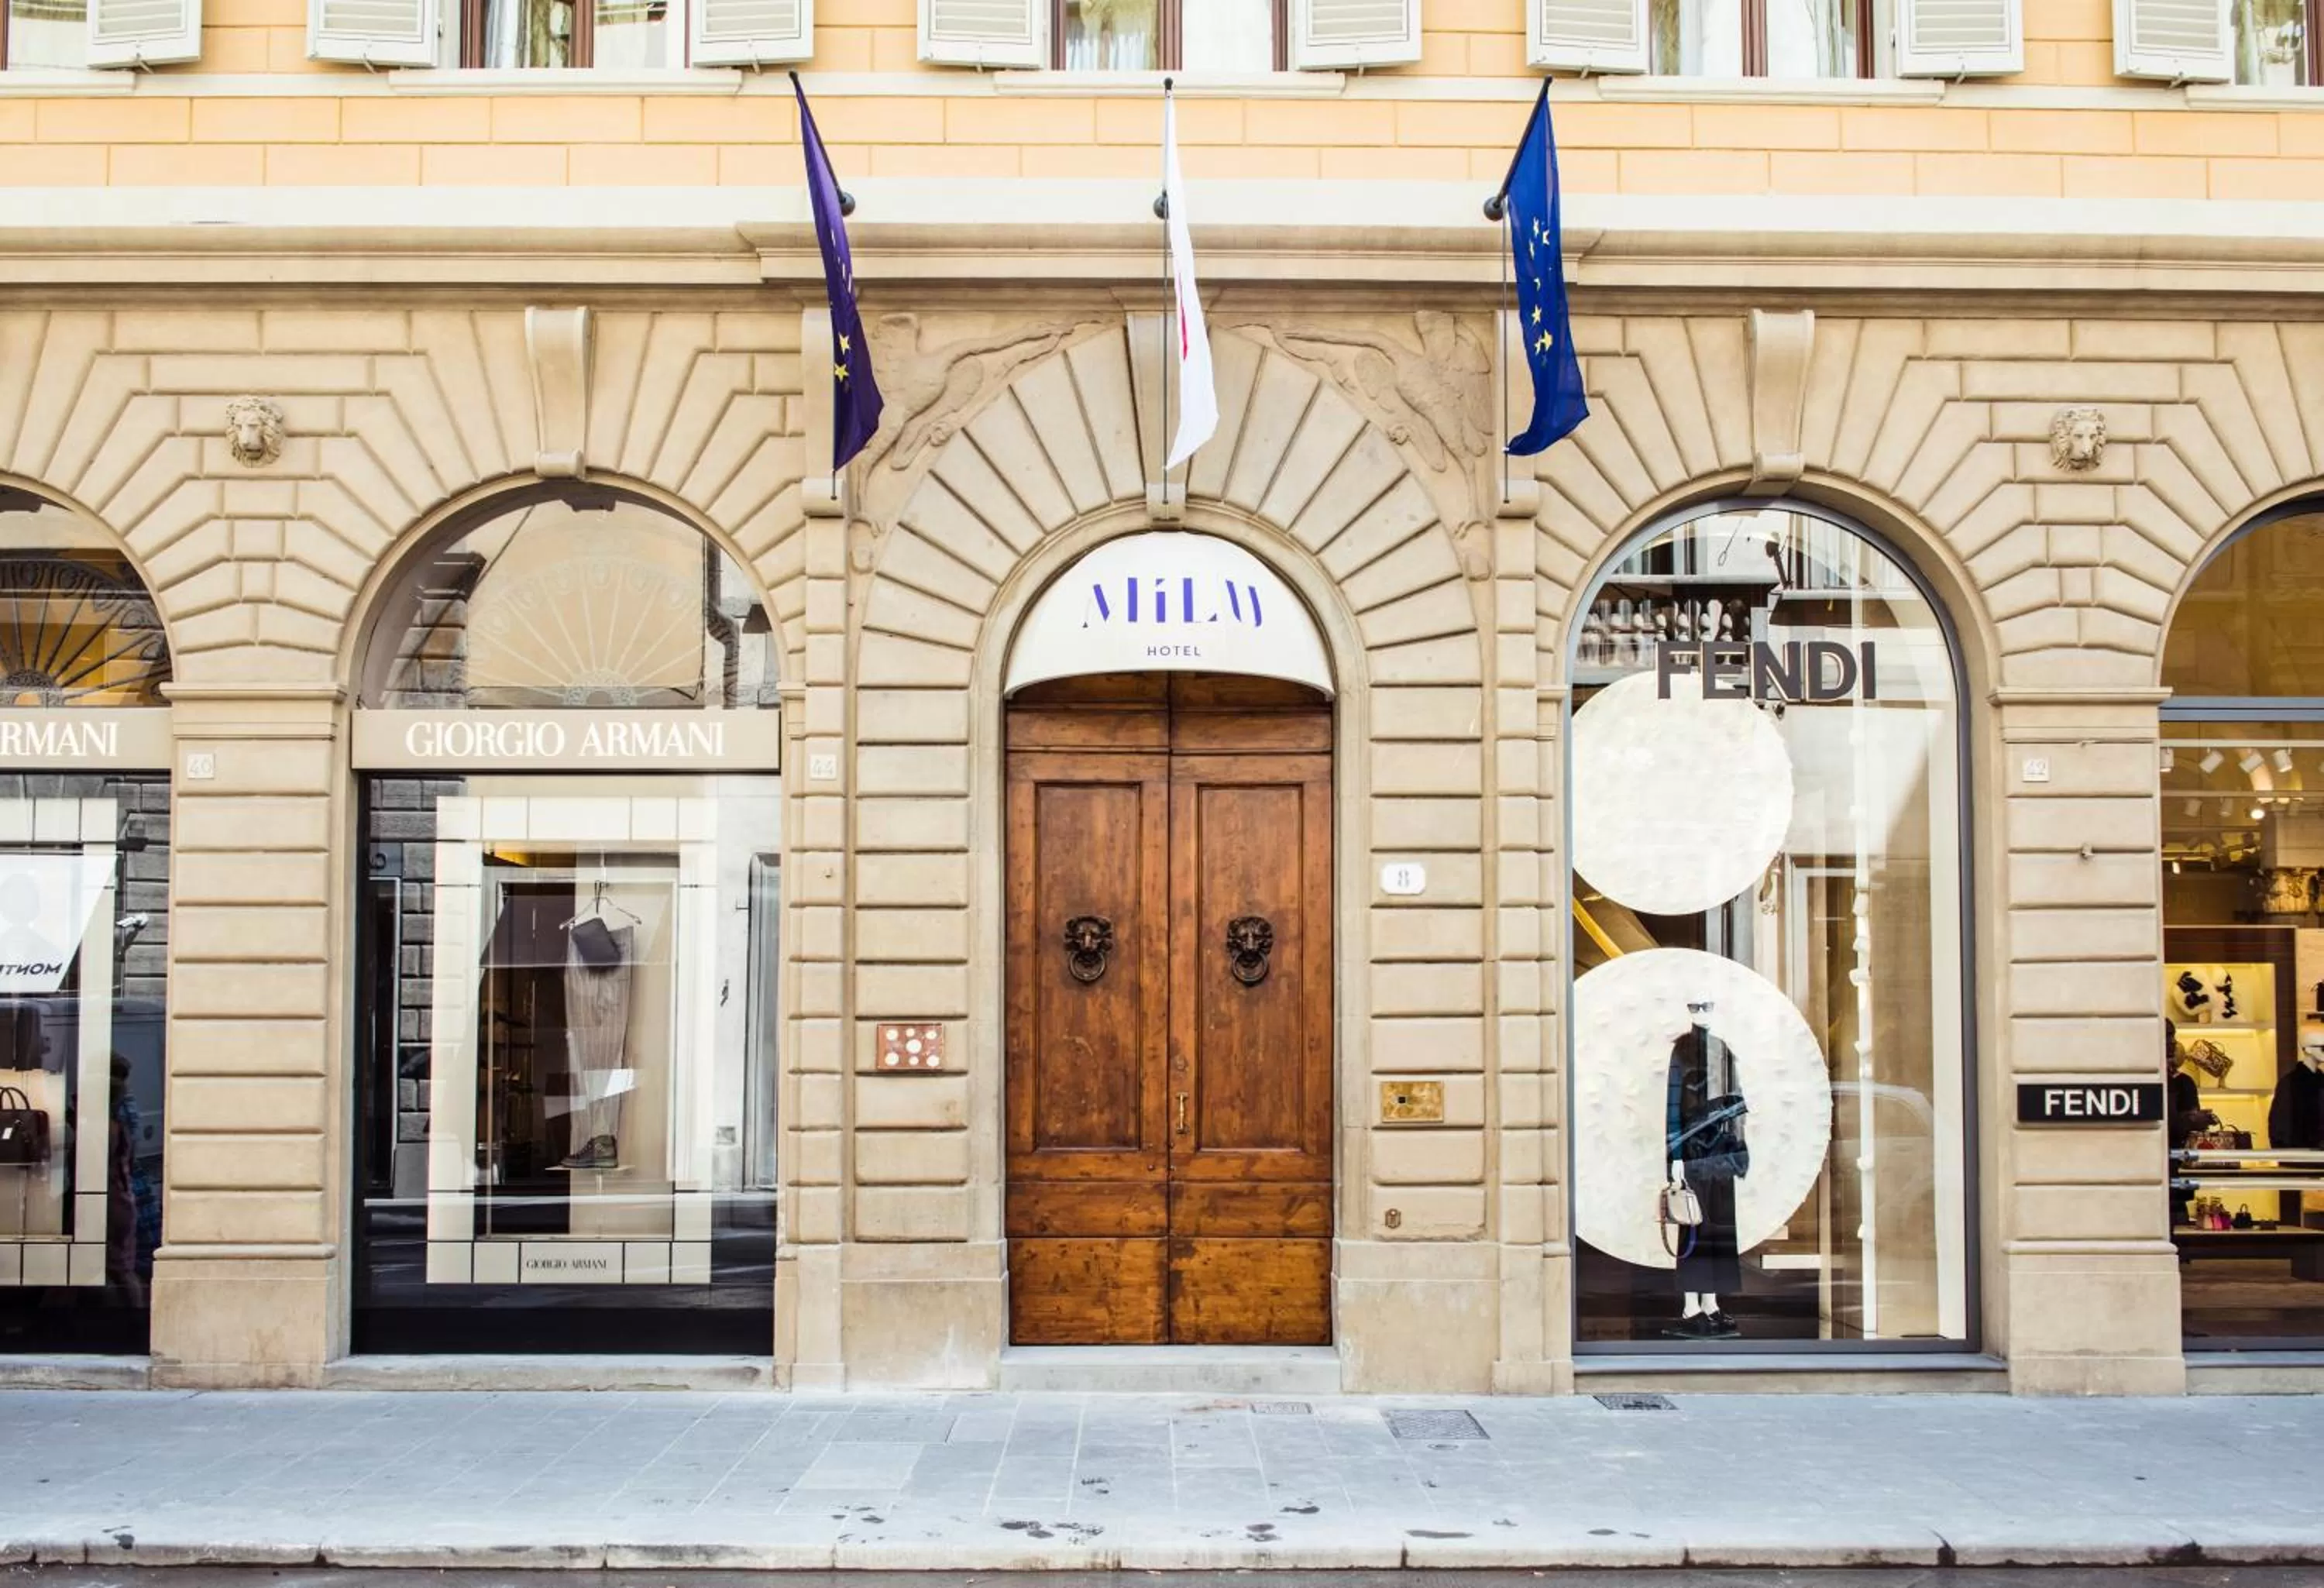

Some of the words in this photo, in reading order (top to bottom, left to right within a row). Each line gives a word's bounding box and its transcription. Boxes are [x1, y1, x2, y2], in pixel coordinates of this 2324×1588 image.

[1147, 645, 1202, 657] HOTEL
[1655, 641, 1876, 702] FENDI
[0, 721, 119, 757] RMANI
[405, 720, 565, 758] GIORGIO
[579, 720, 726, 758] ARMANI
[1397, 868, 1410, 889] 8
[2044, 1088, 2140, 1115] FENDI
